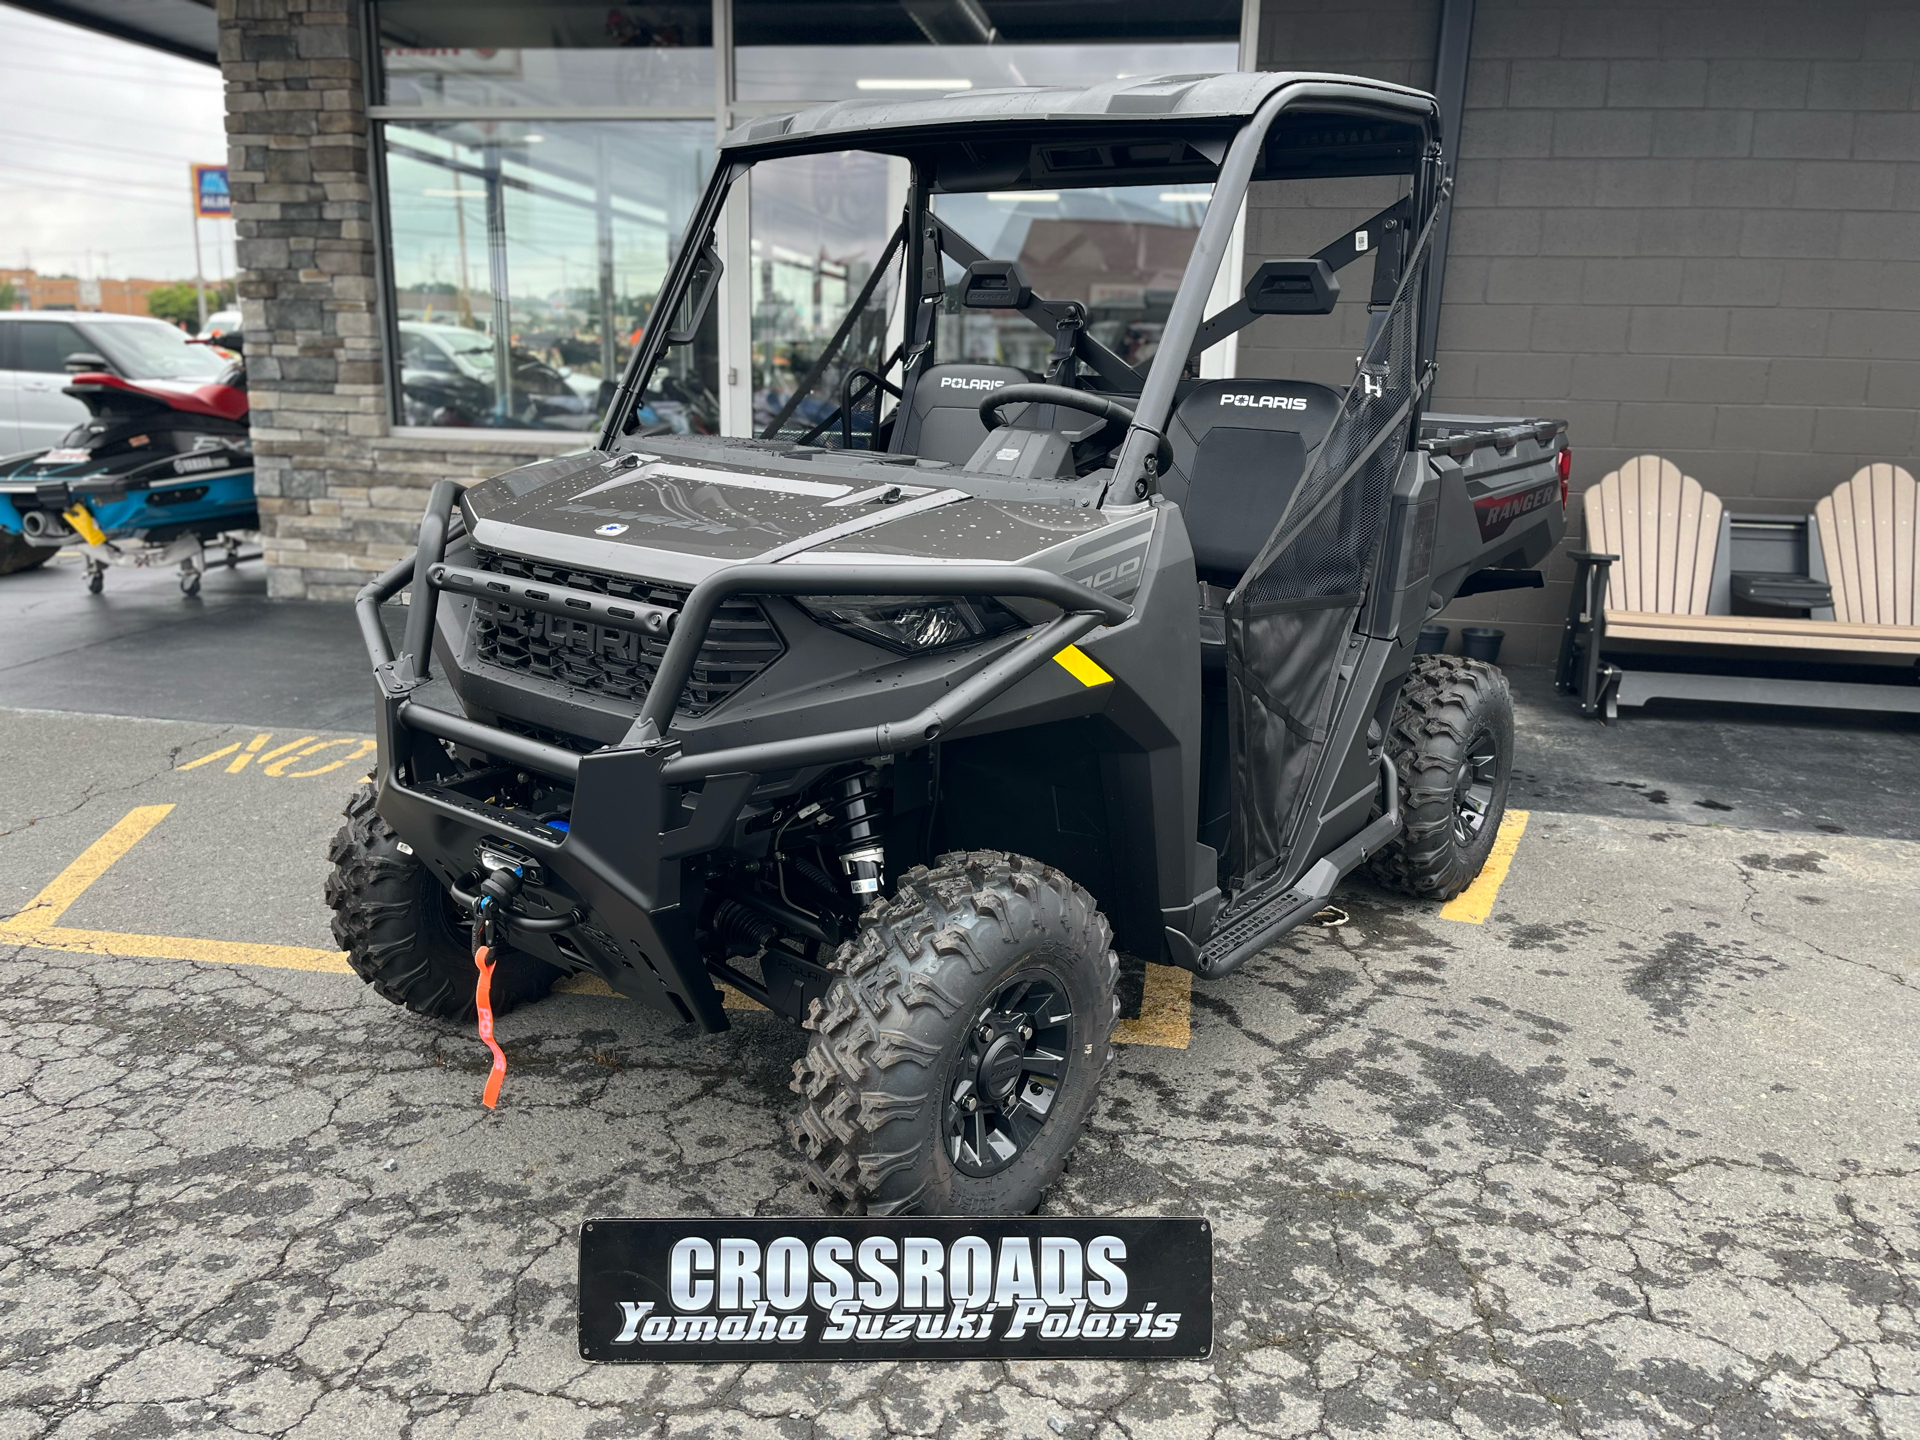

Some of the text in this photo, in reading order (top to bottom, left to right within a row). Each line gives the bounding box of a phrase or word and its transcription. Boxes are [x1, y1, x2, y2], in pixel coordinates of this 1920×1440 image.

[1220, 394, 1308, 411] POLARIS
[553, 504, 738, 535] RANGER
[1485, 486, 1554, 527] RANGER
[670, 1235, 1128, 1311] CROSSROADS
[612, 1298, 1182, 1344] Yamaha Suzuki Polaris
